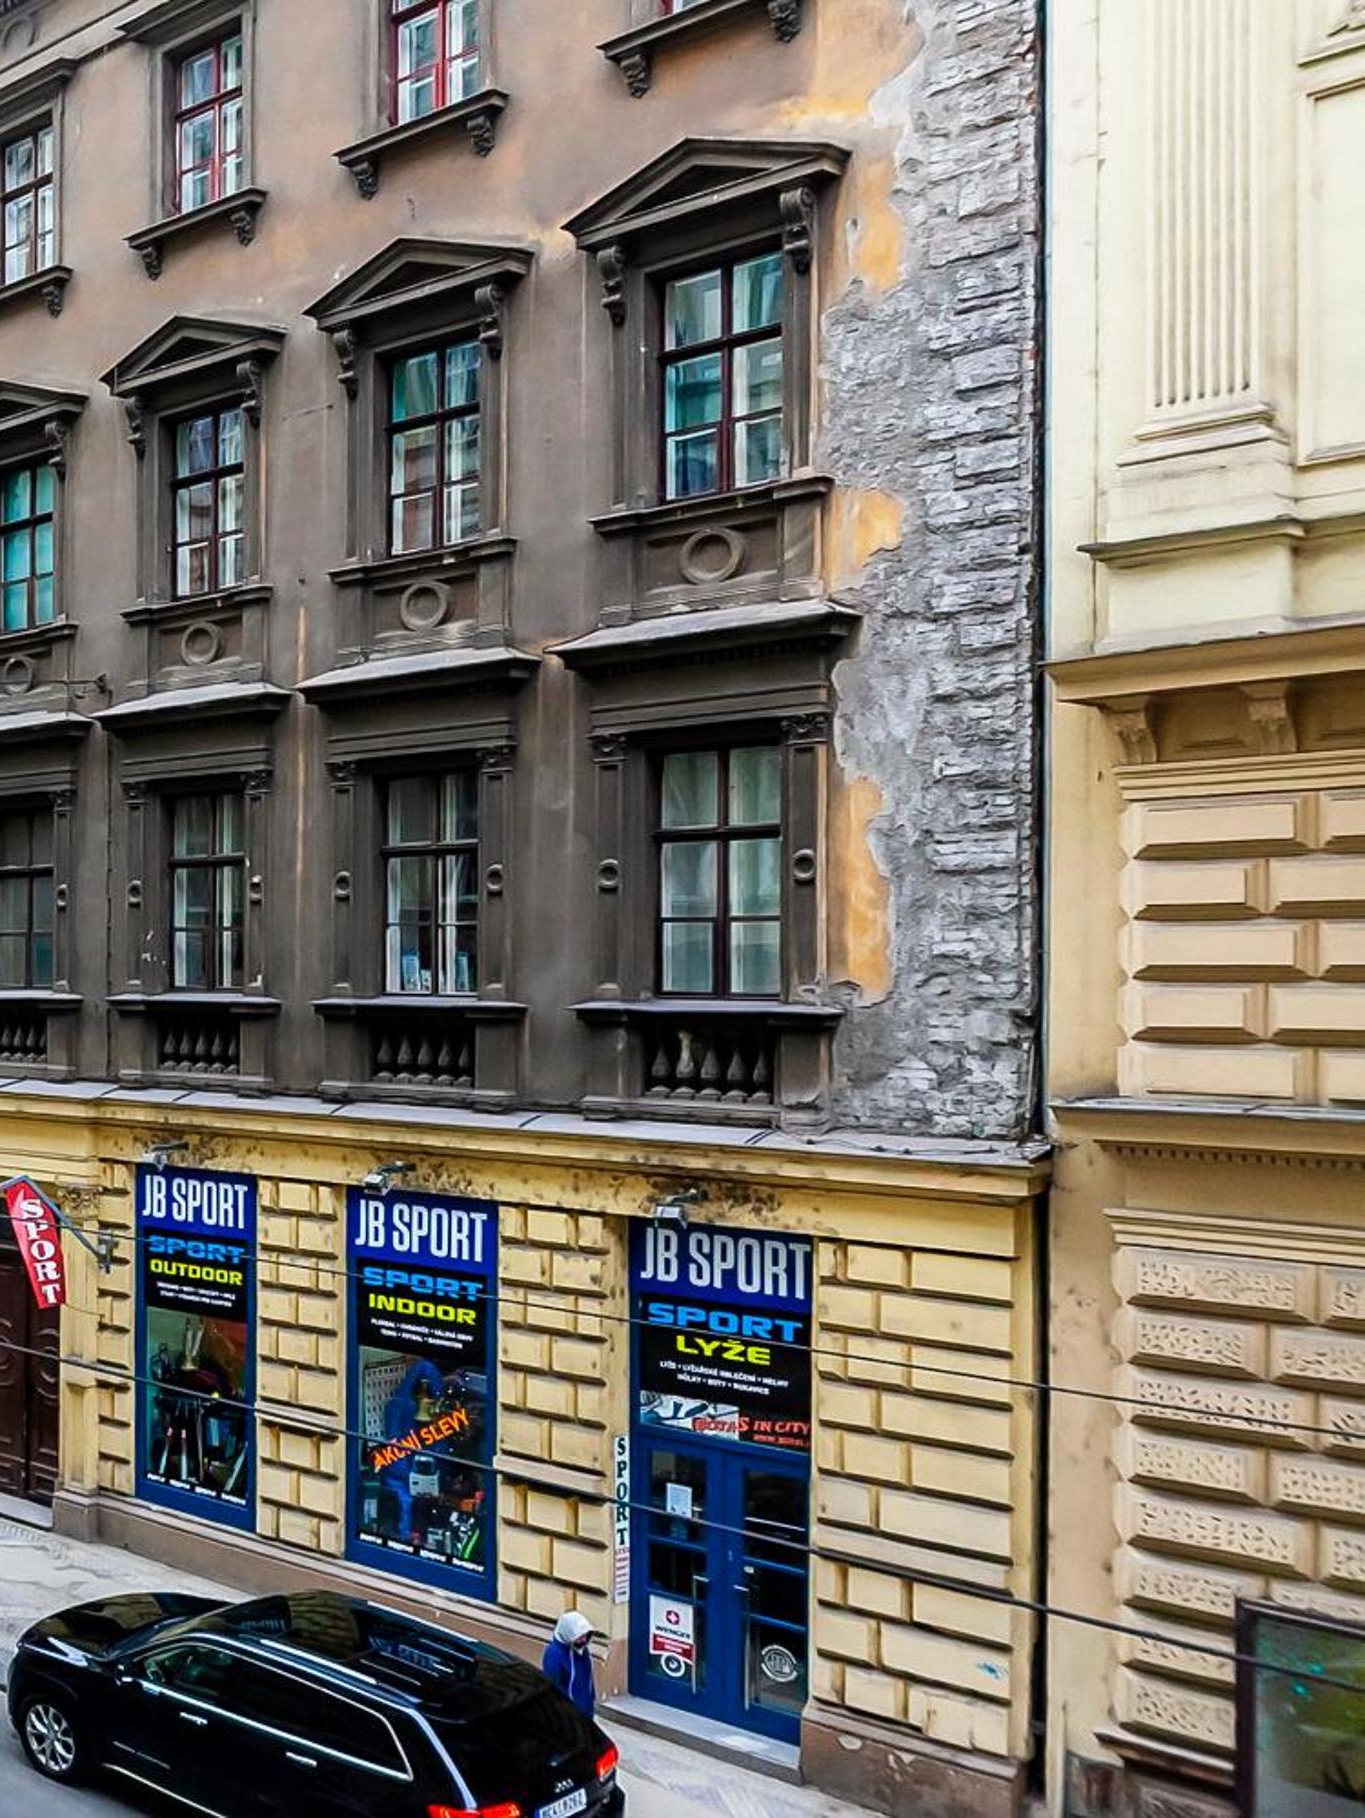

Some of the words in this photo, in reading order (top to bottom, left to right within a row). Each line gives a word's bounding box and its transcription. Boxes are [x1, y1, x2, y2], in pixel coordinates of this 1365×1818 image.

[142, 1175, 167, 1218] JB
[172, 1177, 248, 1230] SPORT
[149, 1235, 245, 1264] SPORT
[355, 1199, 385, 1248] JB
[392, 1203, 488, 1263] SPORT
[19, 1199, 61, 1304] SPORT
[640, 1227, 678, 1282] JB
[689, 1231, 811, 1299] SPORT
[150, 1259, 243, 1285] OUTDOOR
[363, 1266, 483, 1301] SPORT
[369, 1293, 476, 1325] INDOOR
[648, 1302, 803, 1342] SPORT
[676, 1334, 771, 1366] LYŽE
[420, 1408, 468, 1445] SLEVY
[774, 1421, 811, 1435] CITY
[616, 1437, 628, 1546] SPORT
